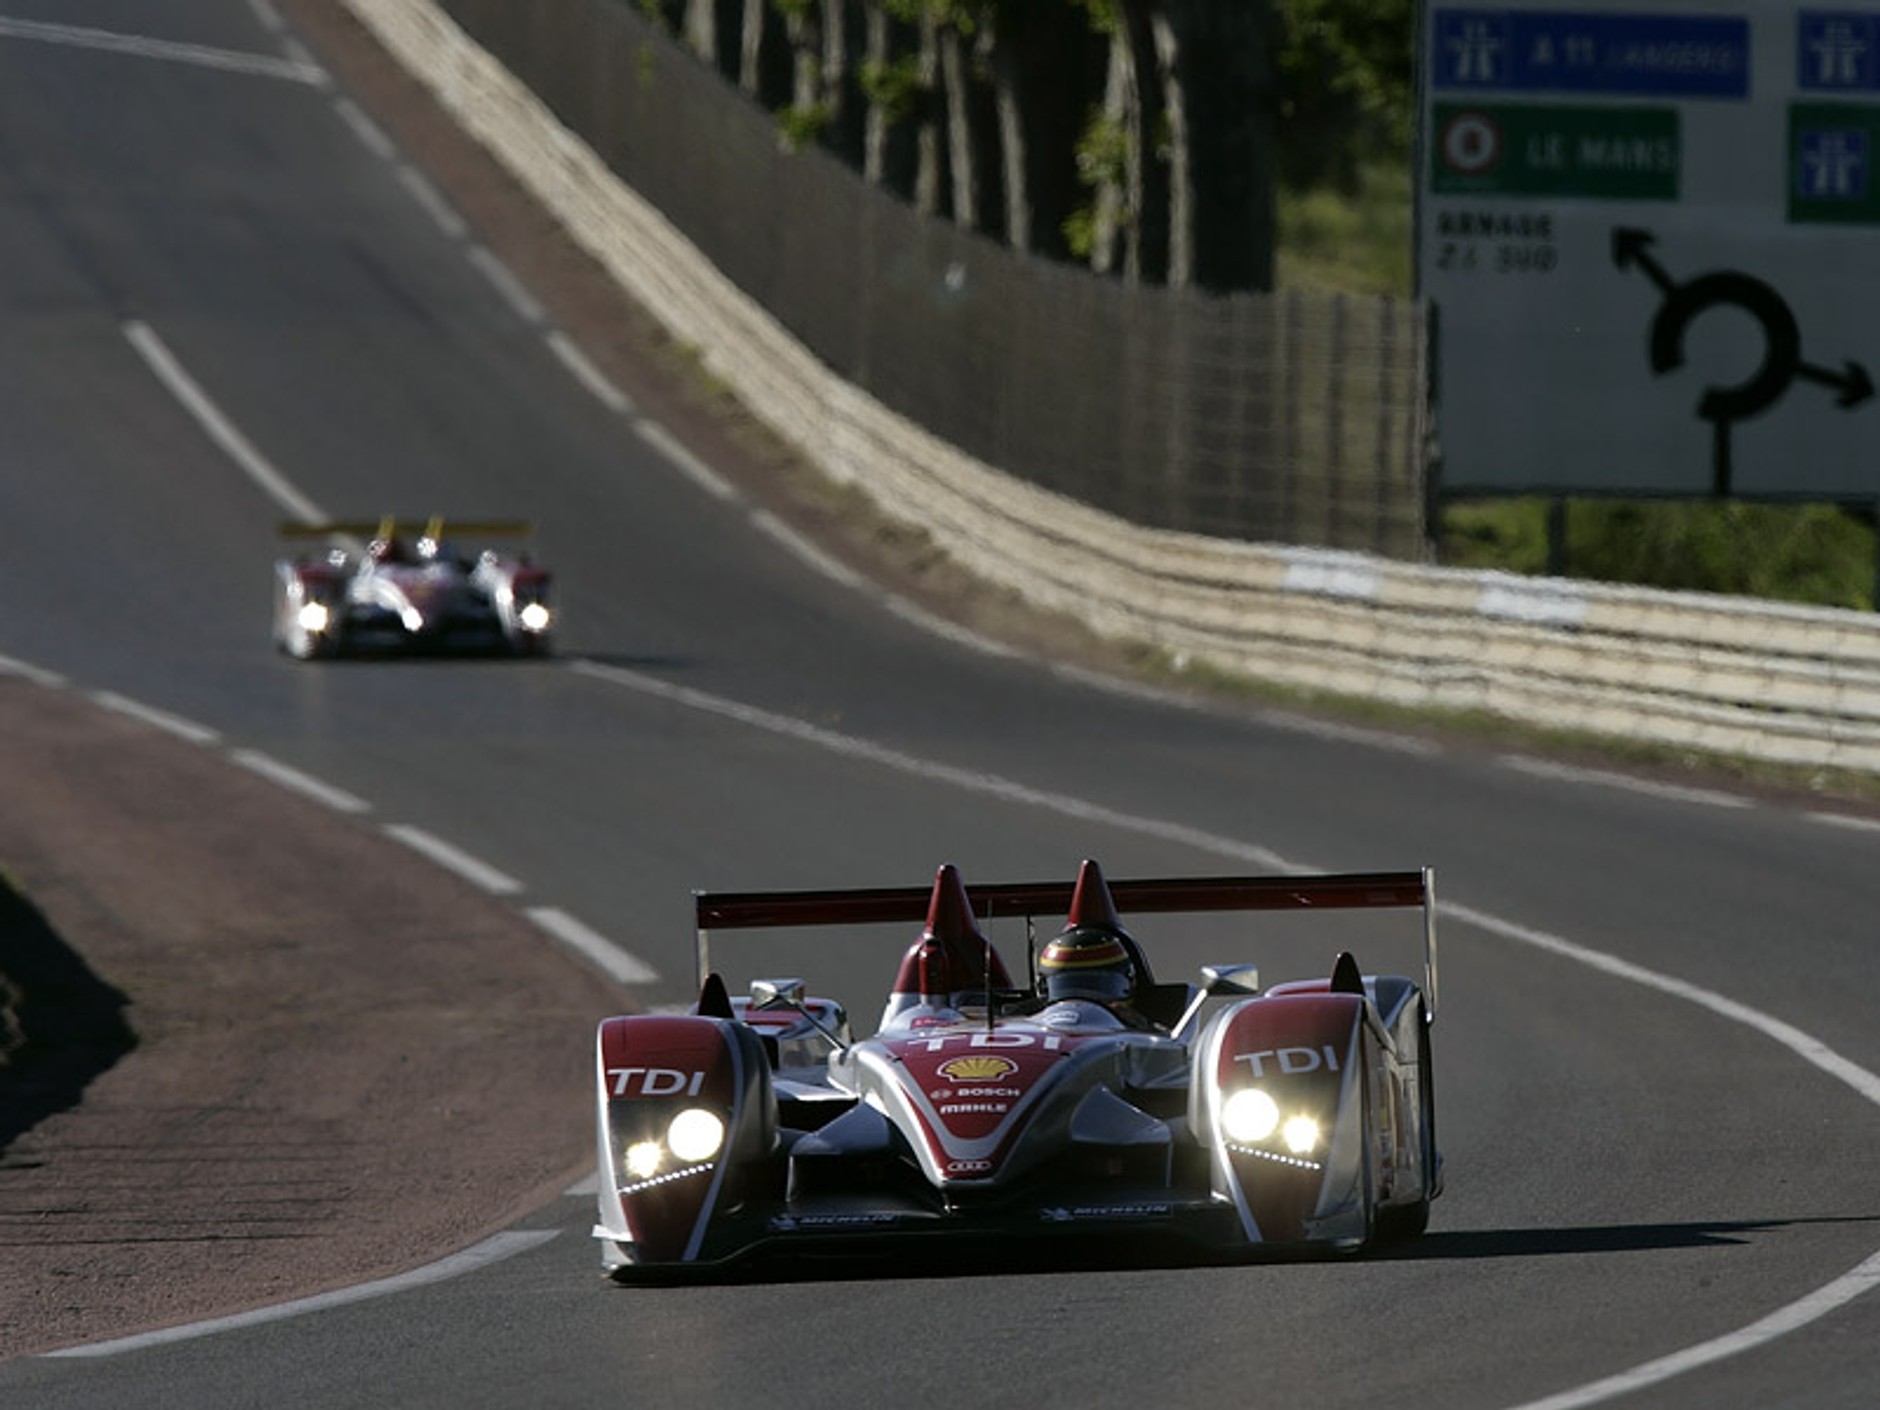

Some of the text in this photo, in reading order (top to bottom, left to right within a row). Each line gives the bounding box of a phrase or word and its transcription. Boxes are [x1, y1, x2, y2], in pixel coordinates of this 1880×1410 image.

[1530, 33, 1554, 64] A
[1526, 133, 1675, 172] LE MANS
[908, 1034, 1061, 1051] TDI
[1233, 1045, 1339, 1078] TDI
[607, 1068, 705, 1097] TDI
[957, 1087, 1020, 1097] BOSCH
[940, 1103, 1008, 1115] MAHLE
